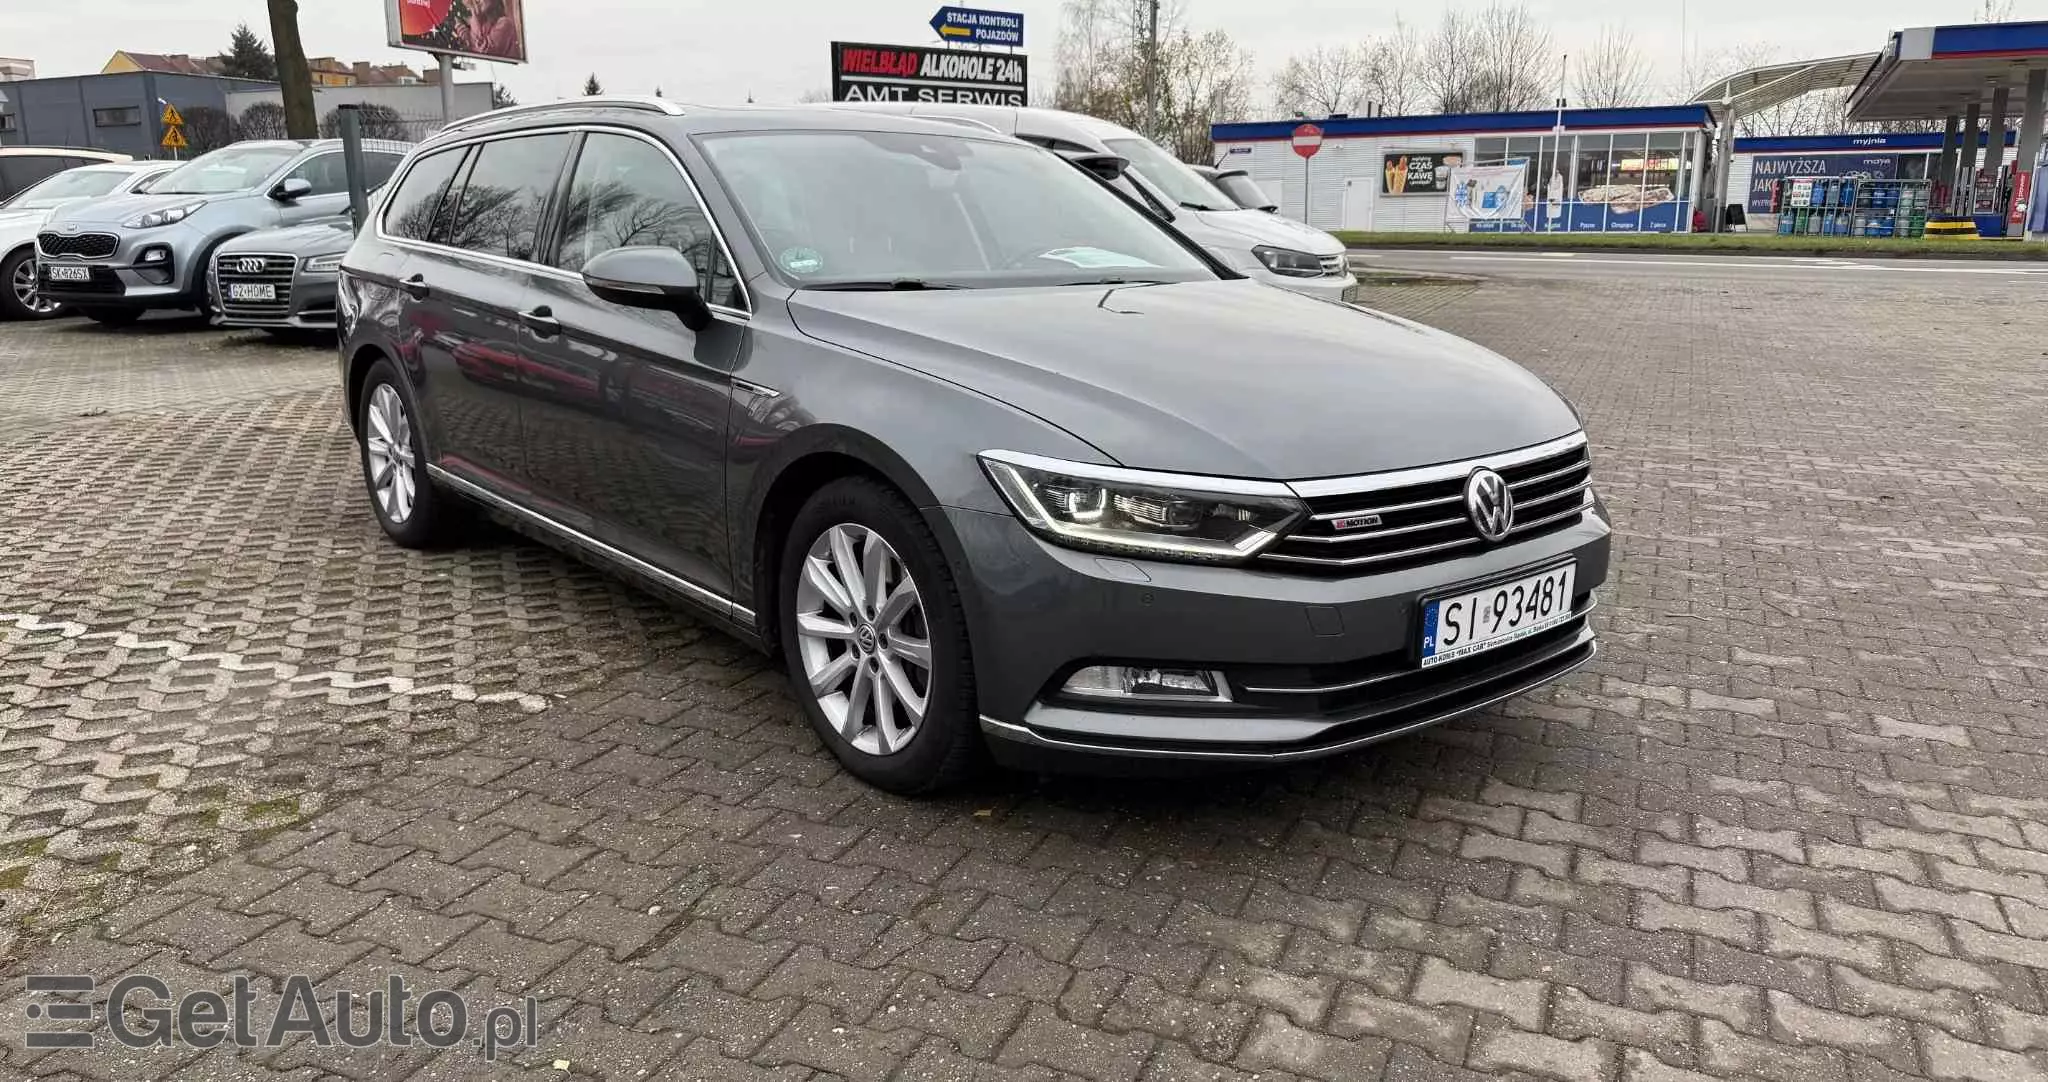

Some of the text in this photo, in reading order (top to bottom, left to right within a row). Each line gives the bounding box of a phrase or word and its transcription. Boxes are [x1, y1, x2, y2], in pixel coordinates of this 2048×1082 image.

[946, 12, 1019, 28] STACJA KONTROLI
[975, 28, 1019, 42] POJAZDÓW
[842, 48, 1023, 83] WIELBŁĄD ALKOHOLE 24h
[844, 84, 1022, 107] AMT SERWIS
[1853, 137, 1887, 146] myjnia
[1755, 157, 1826, 174] NAJWYŻSZA
[1443, 597, 1477, 646] SI
[1491, 569, 1567, 634] 93481
[1424, 636, 1434, 648] PL
